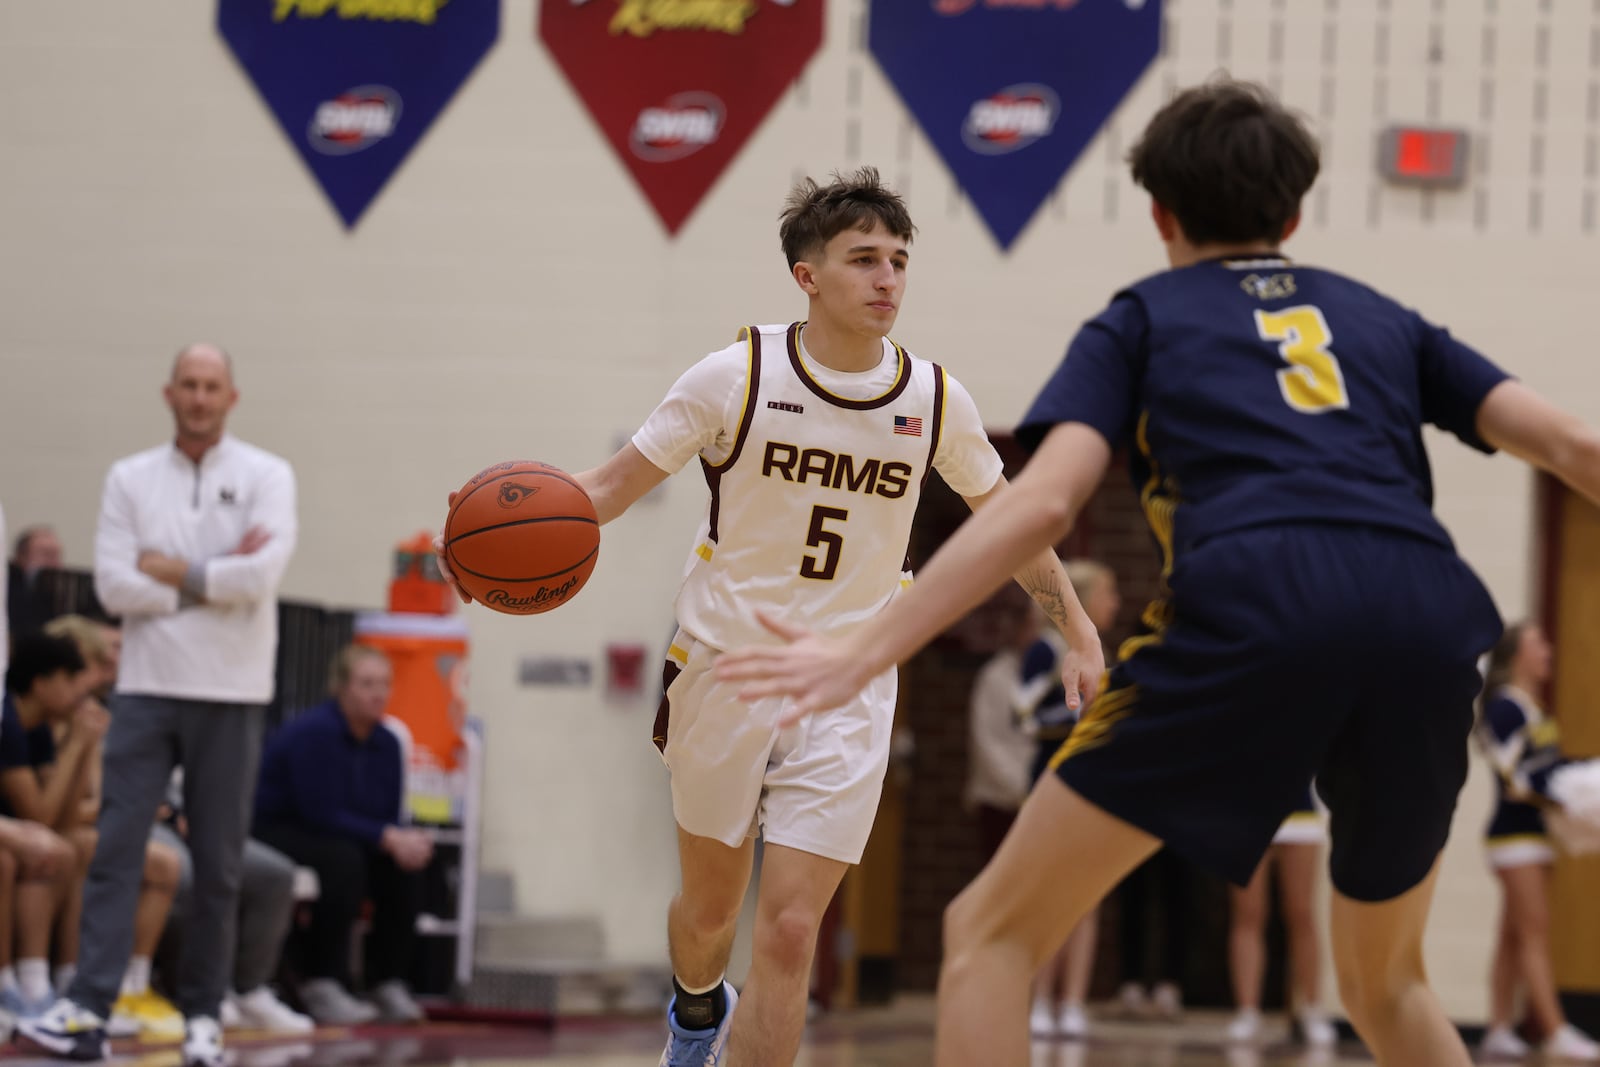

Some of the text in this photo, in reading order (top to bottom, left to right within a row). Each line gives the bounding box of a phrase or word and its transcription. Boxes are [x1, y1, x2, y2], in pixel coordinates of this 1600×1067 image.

[1253, 304, 1350, 414] 3
[762, 440, 912, 499] RAMS
[799, 504, 849, 581] 5
[485, 575, 578, 609] Rawlings
